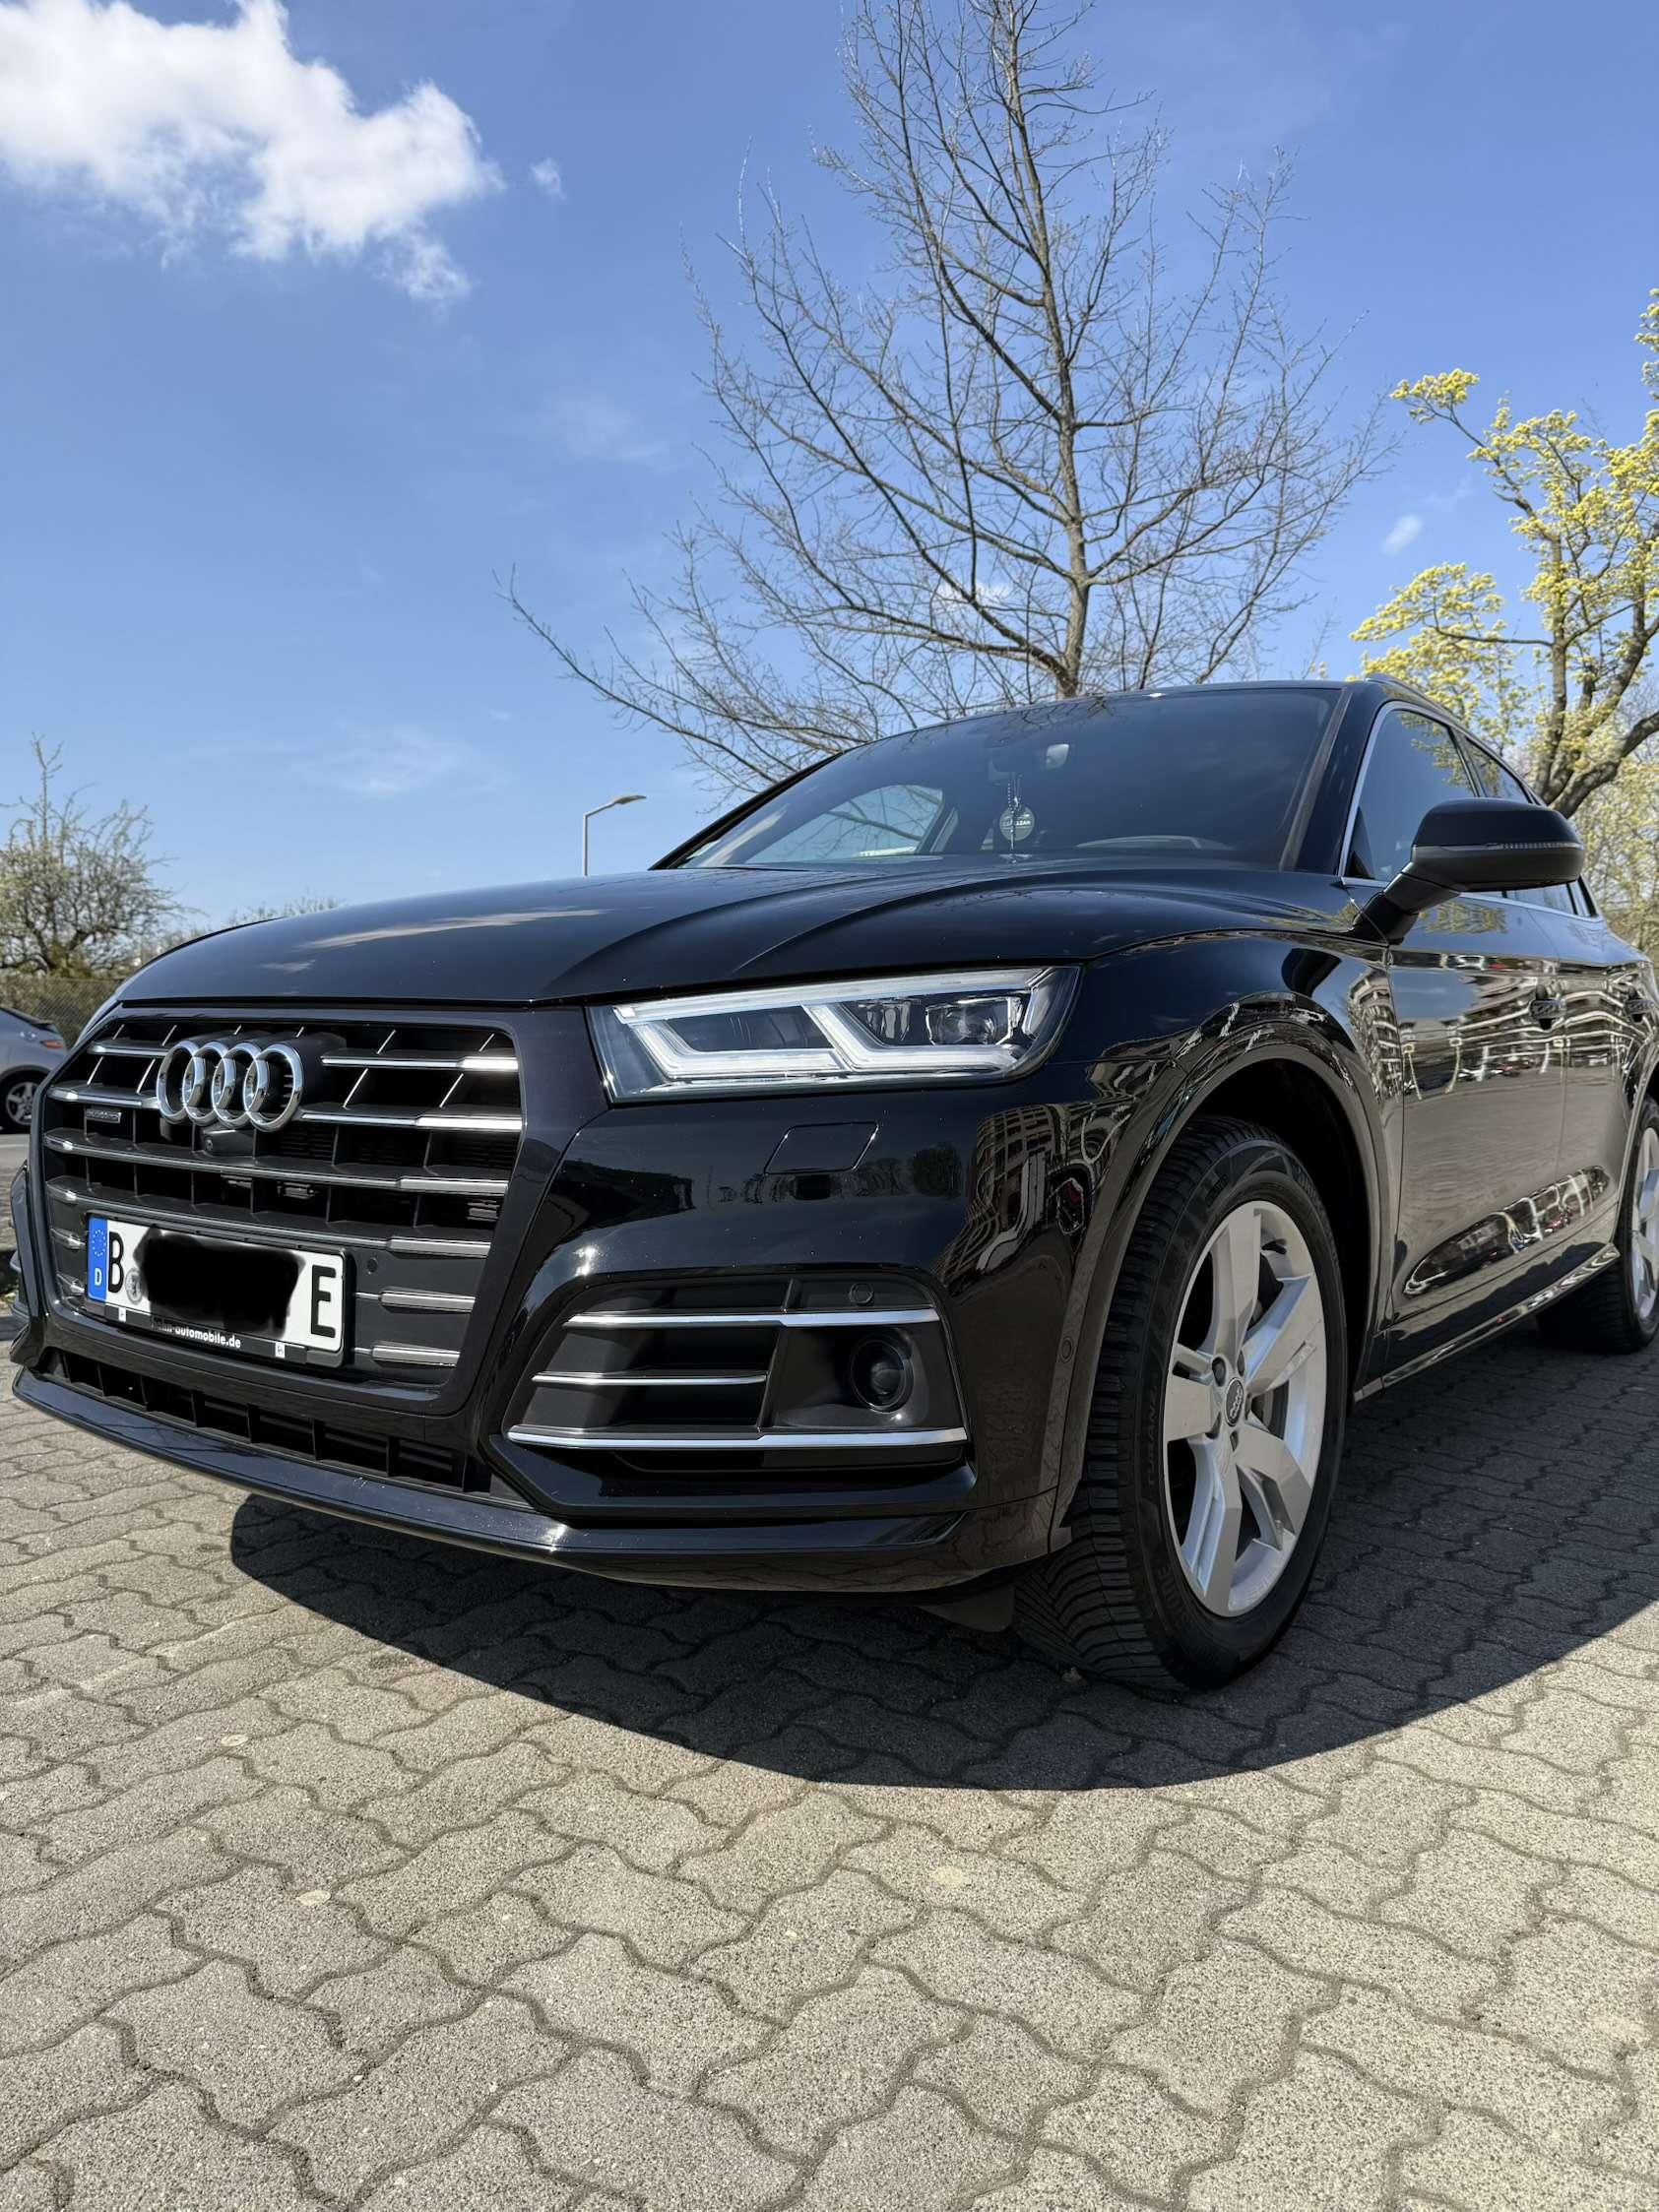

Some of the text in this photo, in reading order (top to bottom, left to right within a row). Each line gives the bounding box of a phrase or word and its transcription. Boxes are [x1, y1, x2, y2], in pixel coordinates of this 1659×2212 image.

[95, 1267, 102, 1286] D
[108, 1231, 337, 1339] B E
